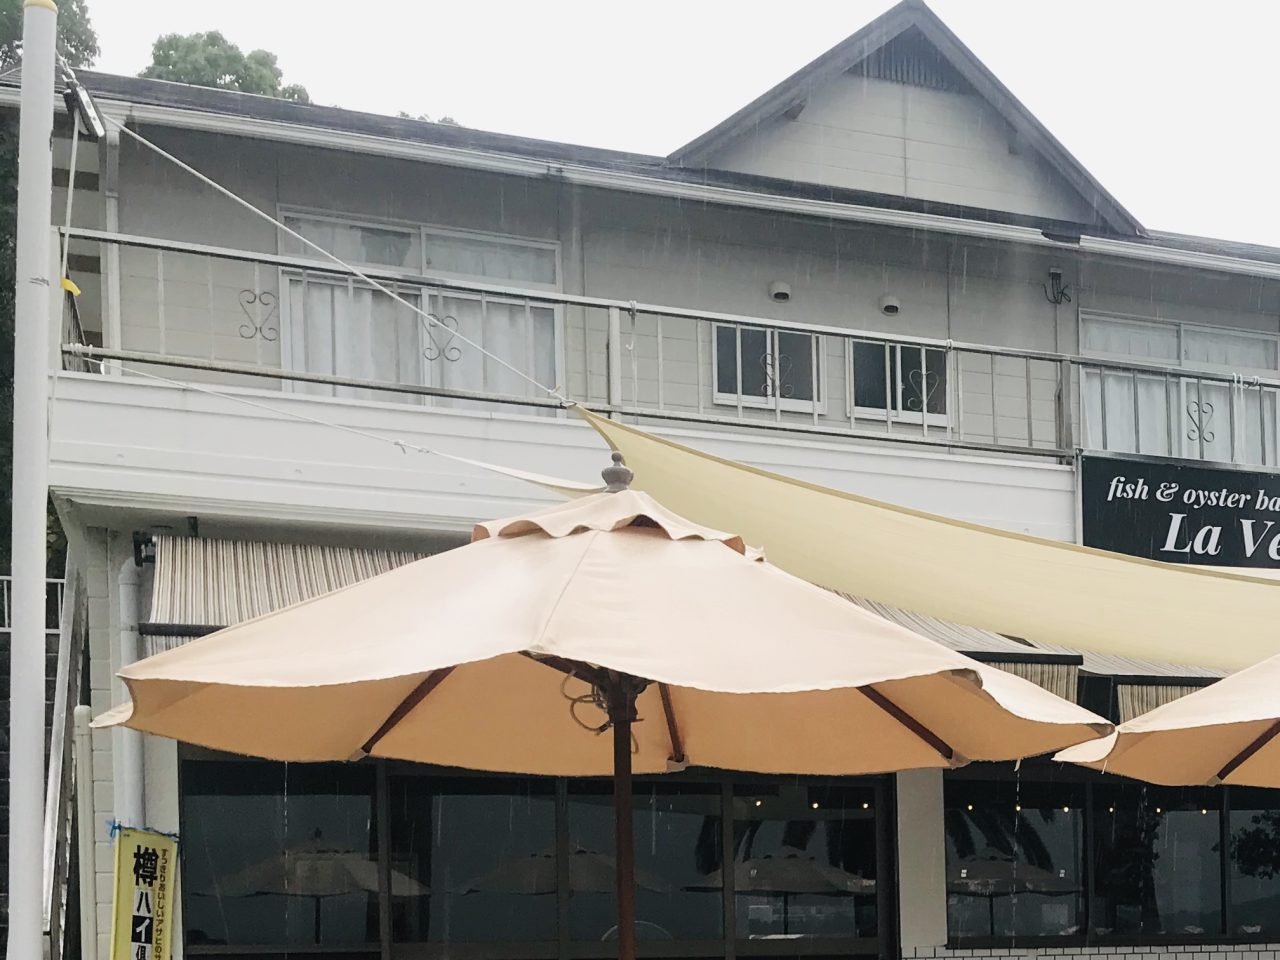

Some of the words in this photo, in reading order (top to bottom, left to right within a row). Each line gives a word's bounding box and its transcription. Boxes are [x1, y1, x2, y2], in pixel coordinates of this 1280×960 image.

[1107, 476, 1149, 501] fish
[1155, 482, 1179, 501] &
[1183, 487, 1251, 509] oyster
[1160, 513, 1221, 556] La
